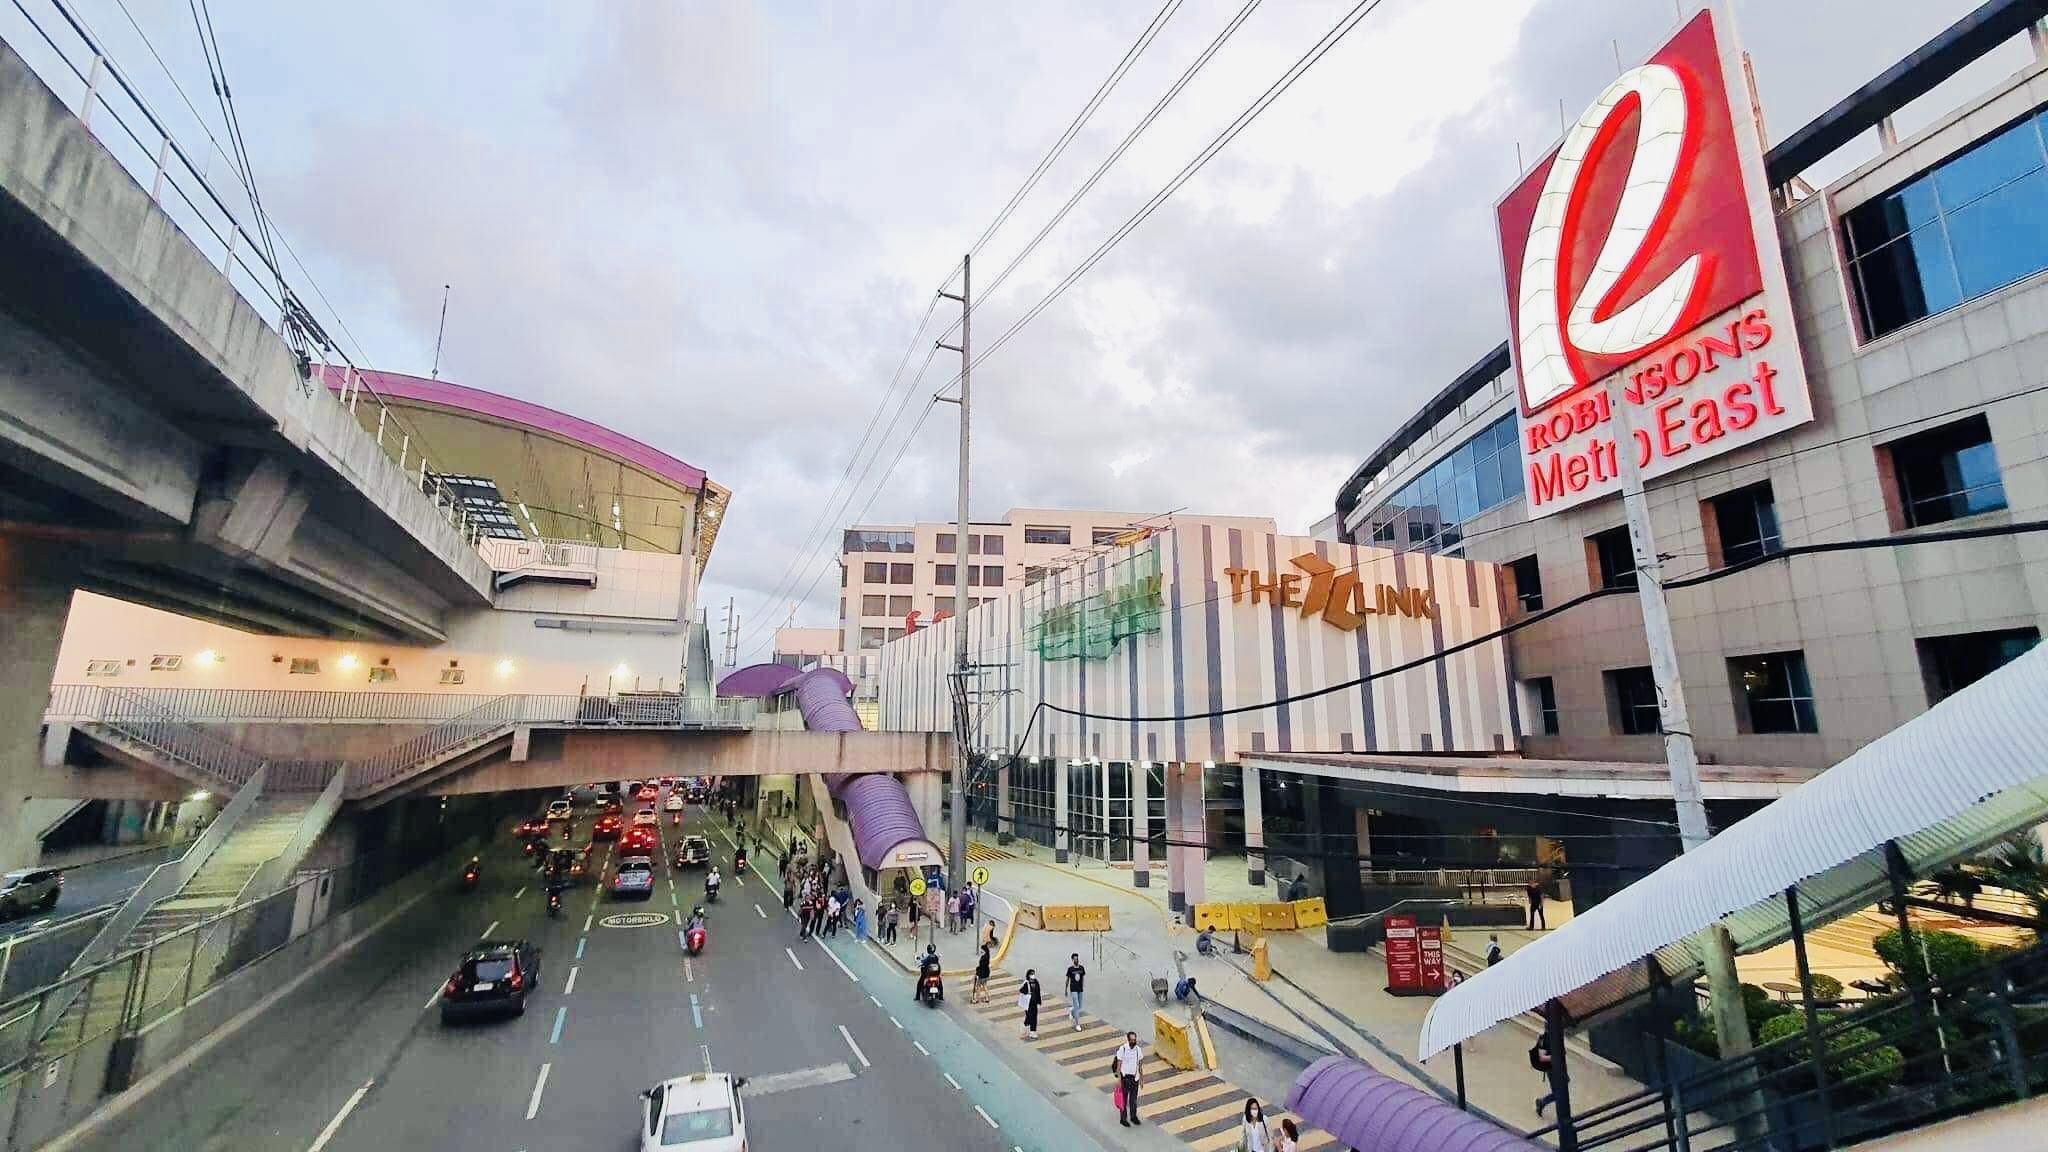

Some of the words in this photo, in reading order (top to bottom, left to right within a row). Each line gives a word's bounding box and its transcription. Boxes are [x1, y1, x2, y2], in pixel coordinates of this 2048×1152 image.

[1224, 567, 1303, 608] THE
[1352, 581, 1437, 619] LINK
[1423, 950, 1441, 958] THIS
[1423, 958, 1441, 966] WAY
